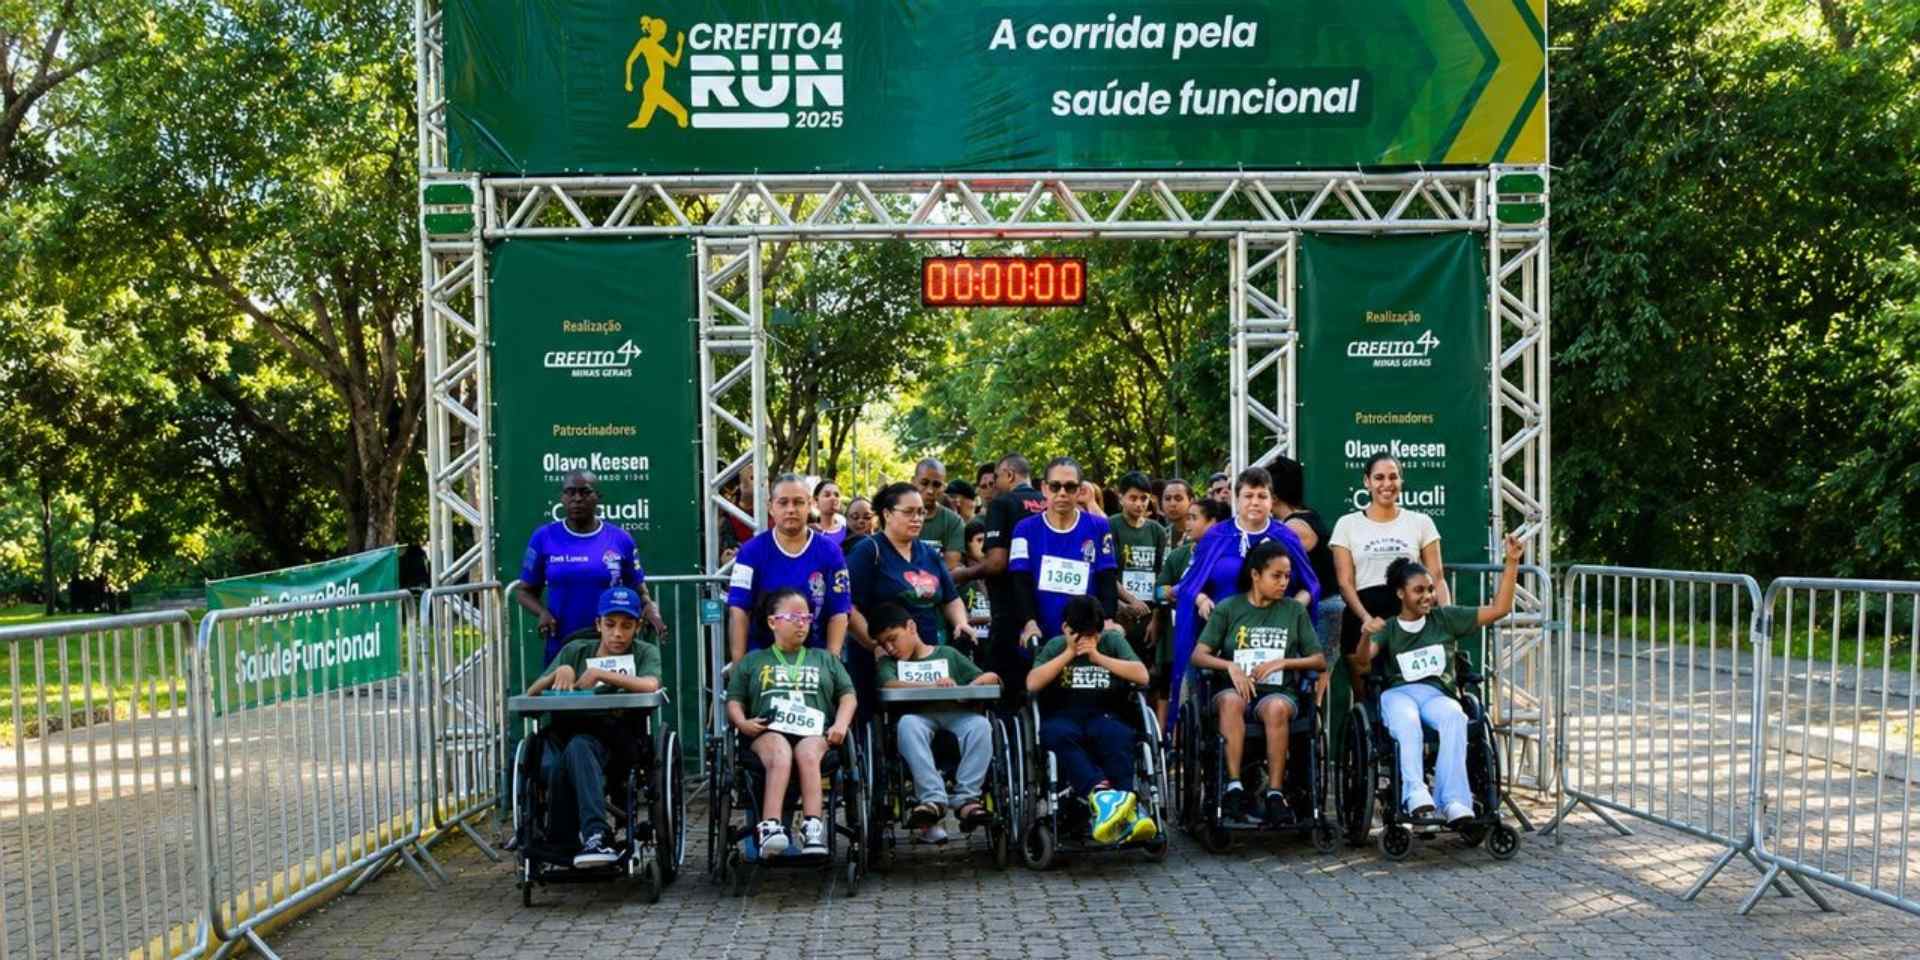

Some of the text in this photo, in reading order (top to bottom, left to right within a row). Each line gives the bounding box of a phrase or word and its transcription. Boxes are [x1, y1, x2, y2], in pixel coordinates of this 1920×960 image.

[688, 22, 843, 50] CREFITO4
[989, 14, 1258, 59] A corrida pela
[690, 54, 844, 107] RUN
[1051, 78, 1360, 116] saúde funcional
[795, 111, 844, 128] 2025
[927, 262, 1081, 301] 00:00:00
[563, 319, 622, 335] Realização
[1366, 311, 1421, 326] Realização
[1355, 411, 1434, 425] Patrocinadores
[552, 423, 637, 437] Patrocinadores
[1390, 439, 1446, 458] Keesen
[543, 452, 649, 471] Olavo Keesen
[1047, 569, 1081, 586] 1369
[1411, 656, 1438, 671] 414
[774, 710, 816, 728] 5056
